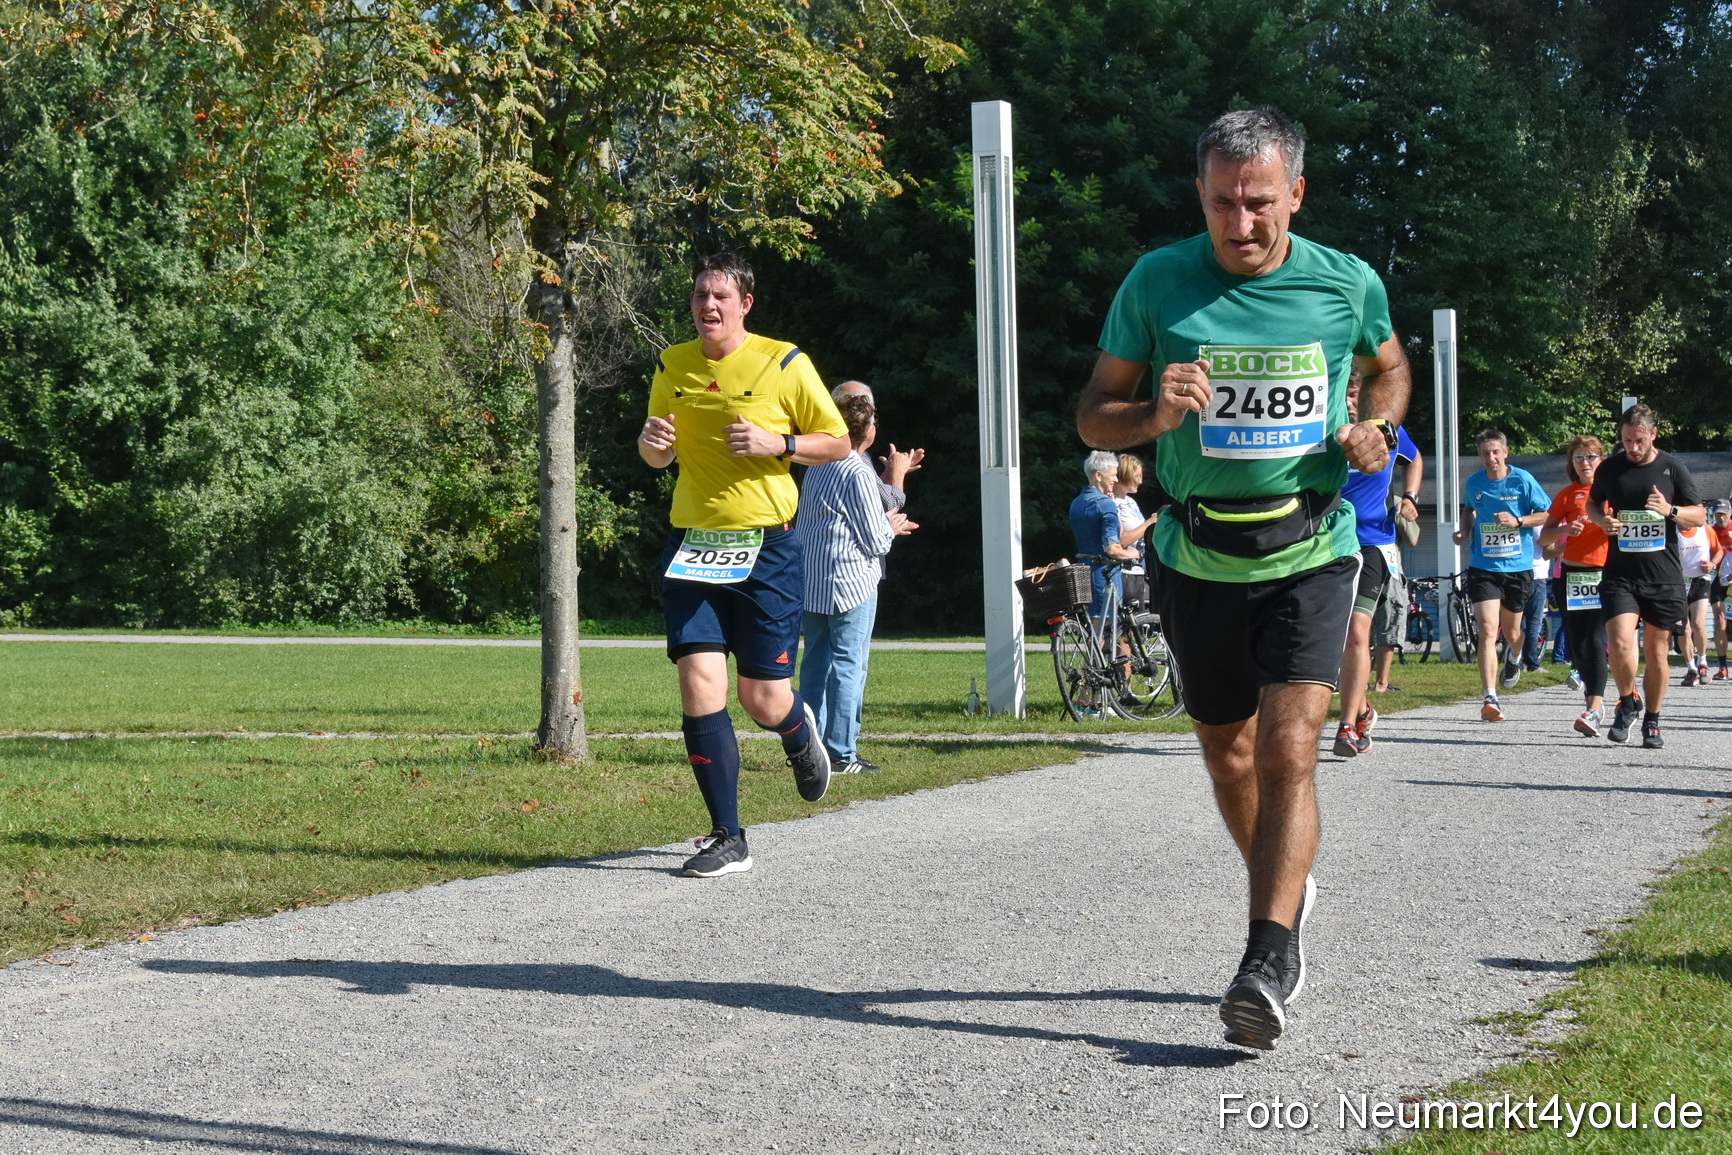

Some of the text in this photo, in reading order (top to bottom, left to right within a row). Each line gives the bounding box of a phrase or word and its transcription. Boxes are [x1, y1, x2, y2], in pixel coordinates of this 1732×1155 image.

[1210, 351, 1319, 376] BOCK
[1215, 385, 1315, 419] 2489
[1227, 430, 1303, 445] ALBERT
[691, 529, 755, 545] BOCK
[1622, 525, 1660, 538] 2185
[1485, 533, 1516, 546] 2216
[1488, 546, 1514, 554] JOHANN
[684, 549, 750, 566] 2059
[684, 568, 735, 578] MARCEL
[1572, 585, 1601, 597] 300
